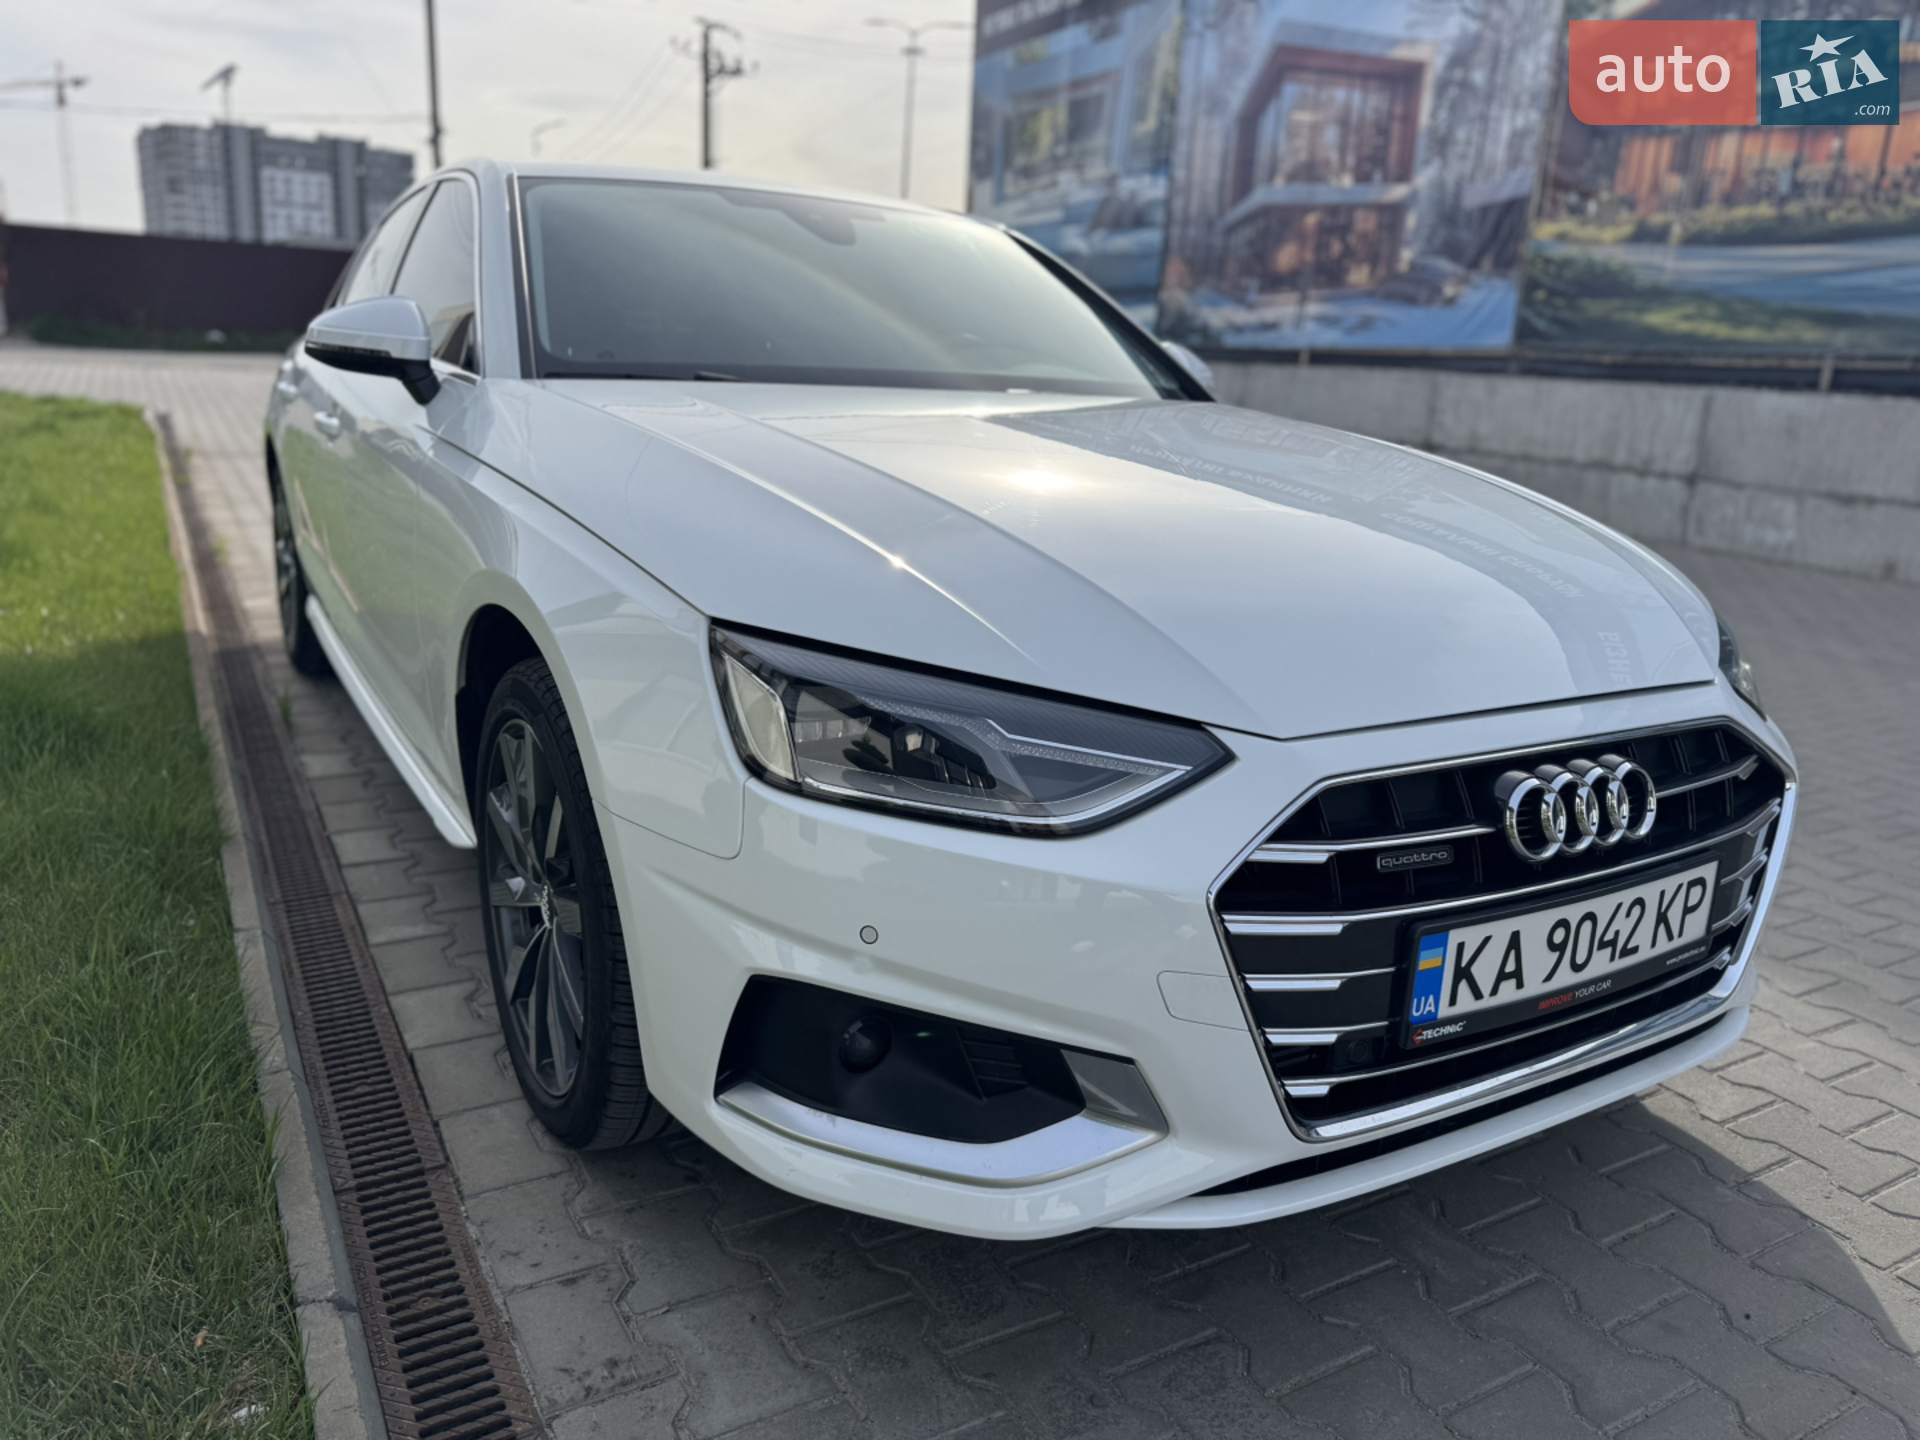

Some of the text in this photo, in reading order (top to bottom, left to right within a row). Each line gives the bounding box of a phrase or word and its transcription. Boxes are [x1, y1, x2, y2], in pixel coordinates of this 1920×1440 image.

[1381, 851, 1447, 867] quattro
[1412, 875, 1708, 1017] UA KA 9042 KP
[1574, 984, 1596, 998] YOUR
[1596, 979, 1612, 992] CAR
